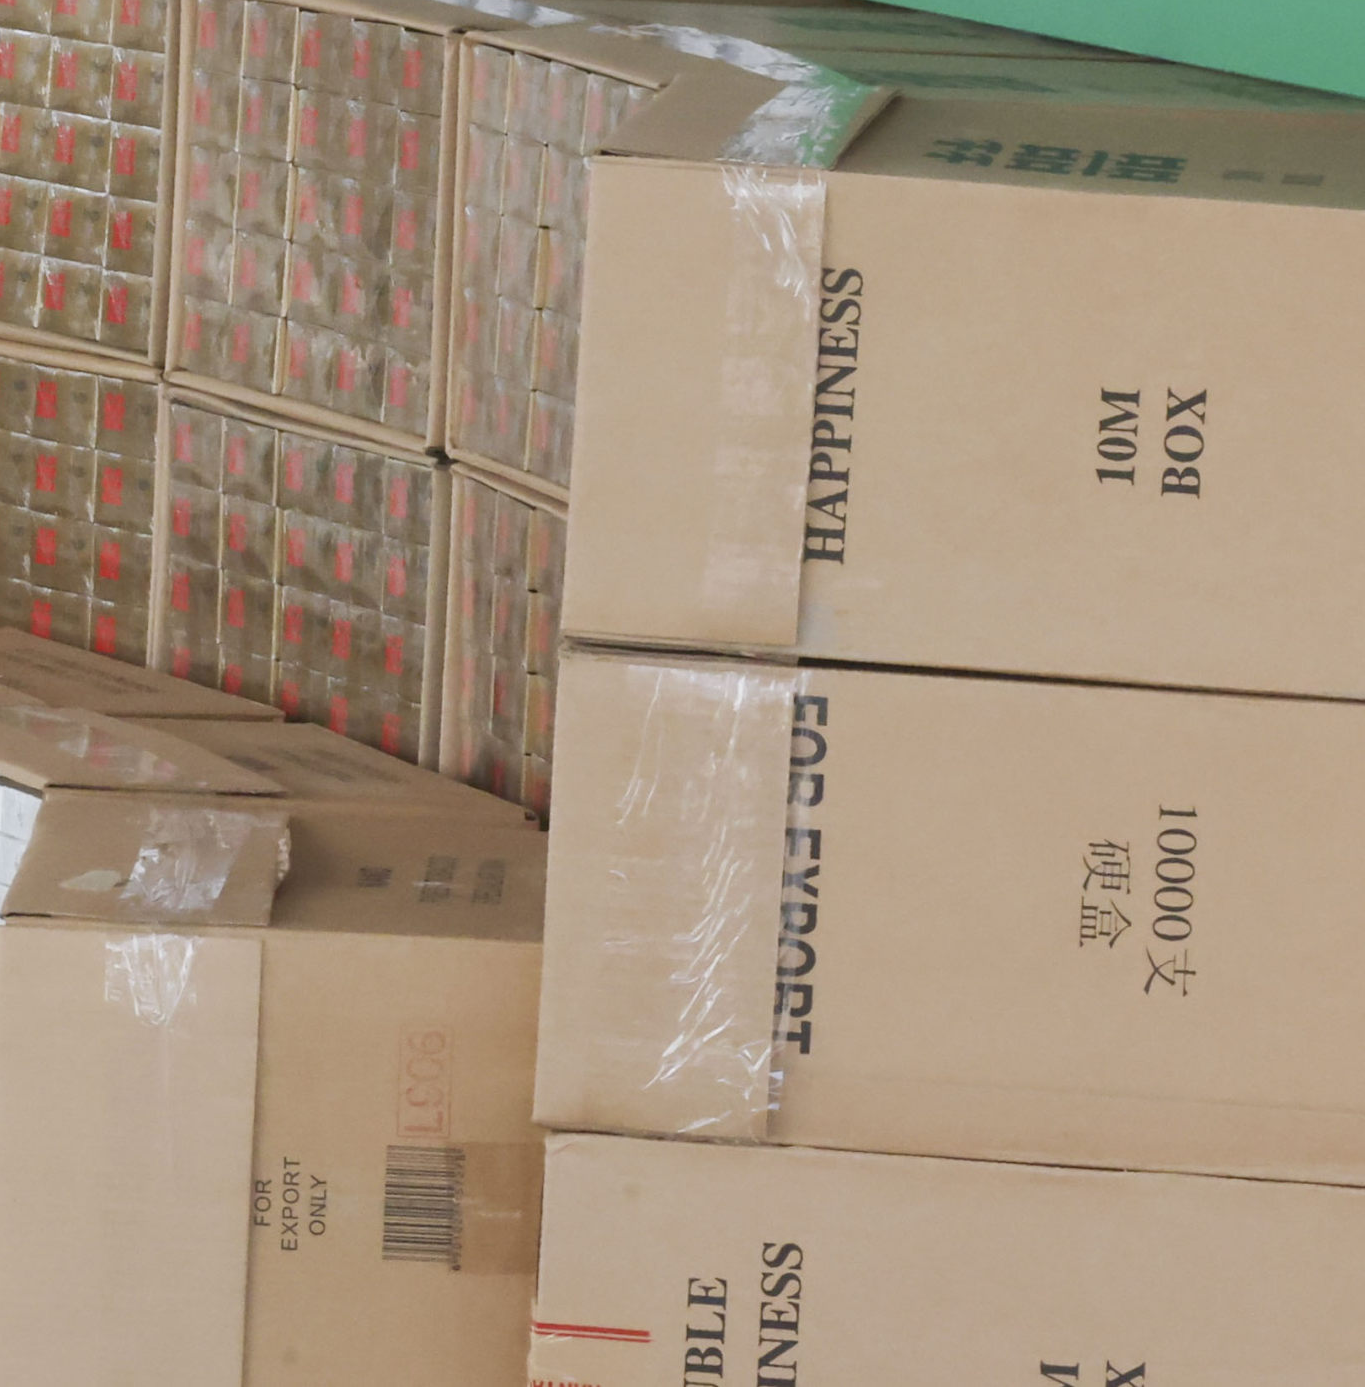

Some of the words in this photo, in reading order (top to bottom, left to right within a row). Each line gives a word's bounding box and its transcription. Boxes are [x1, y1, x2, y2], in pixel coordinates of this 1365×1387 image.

[804, 266, 865, 565] HAPPINESS
[1094, 387, 1141, 487] 10M
[1160, 387, 1208, 499] BOX
[788, 694, 829, 807] FOR
[771, 828, 822, 1055] EXPORT
[1079, 838, 1133, 949] 硬盒
[1143, 802, 1199, 998] 10000支
[253, 1178, 272, 1227] FOR
[281, 1156, 300, 1253] EXPORT
[309, 1175, 328, 1236] ONLY
[683, 1277, 728, 1387] BLE
